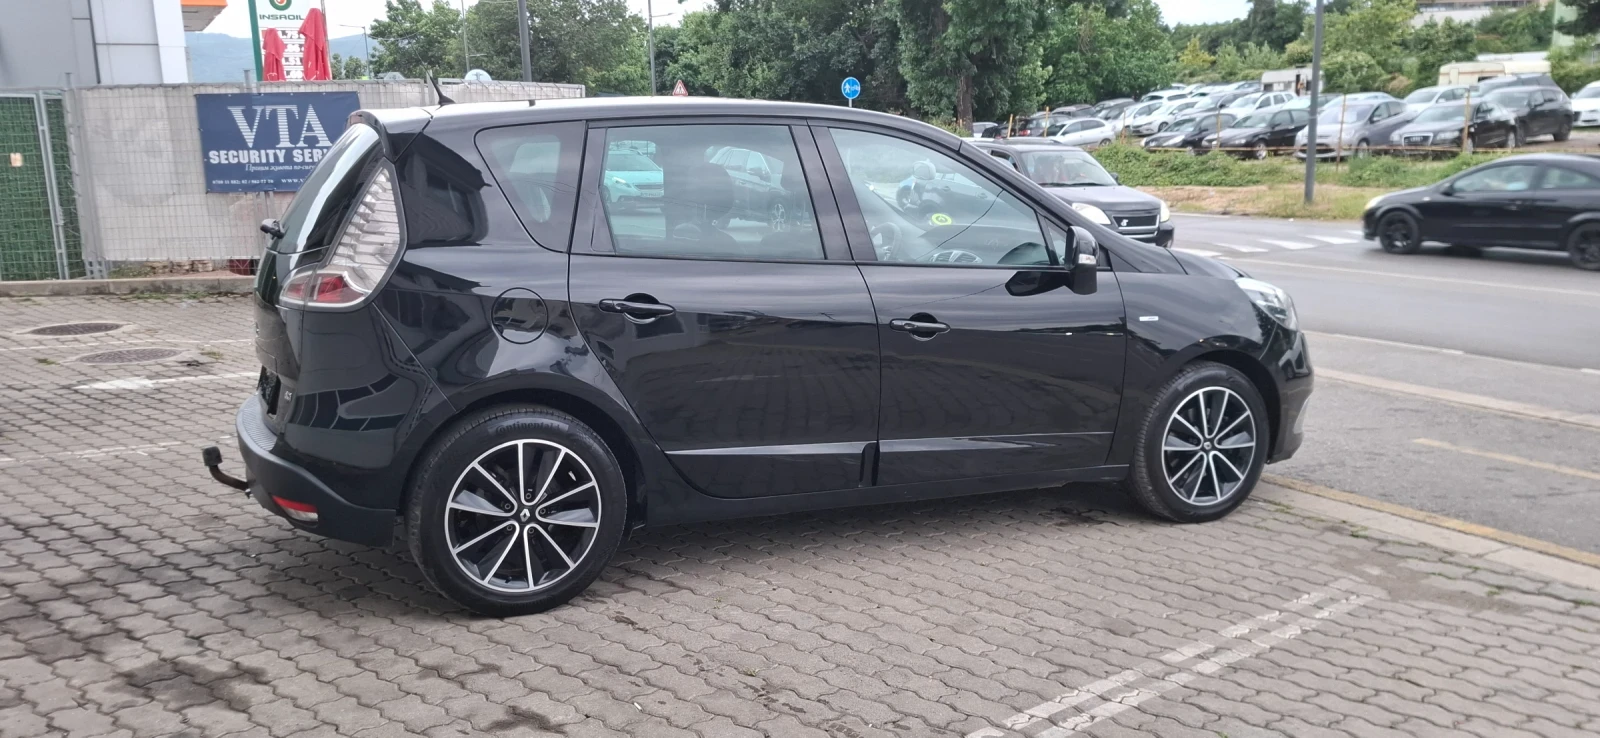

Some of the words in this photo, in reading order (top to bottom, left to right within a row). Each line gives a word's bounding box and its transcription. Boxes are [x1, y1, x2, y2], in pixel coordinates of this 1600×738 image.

[227, 104, 332, 148] VTA
[208, 149, 286, 164] SECURITY
[496, 421, 554, 434] Continental
